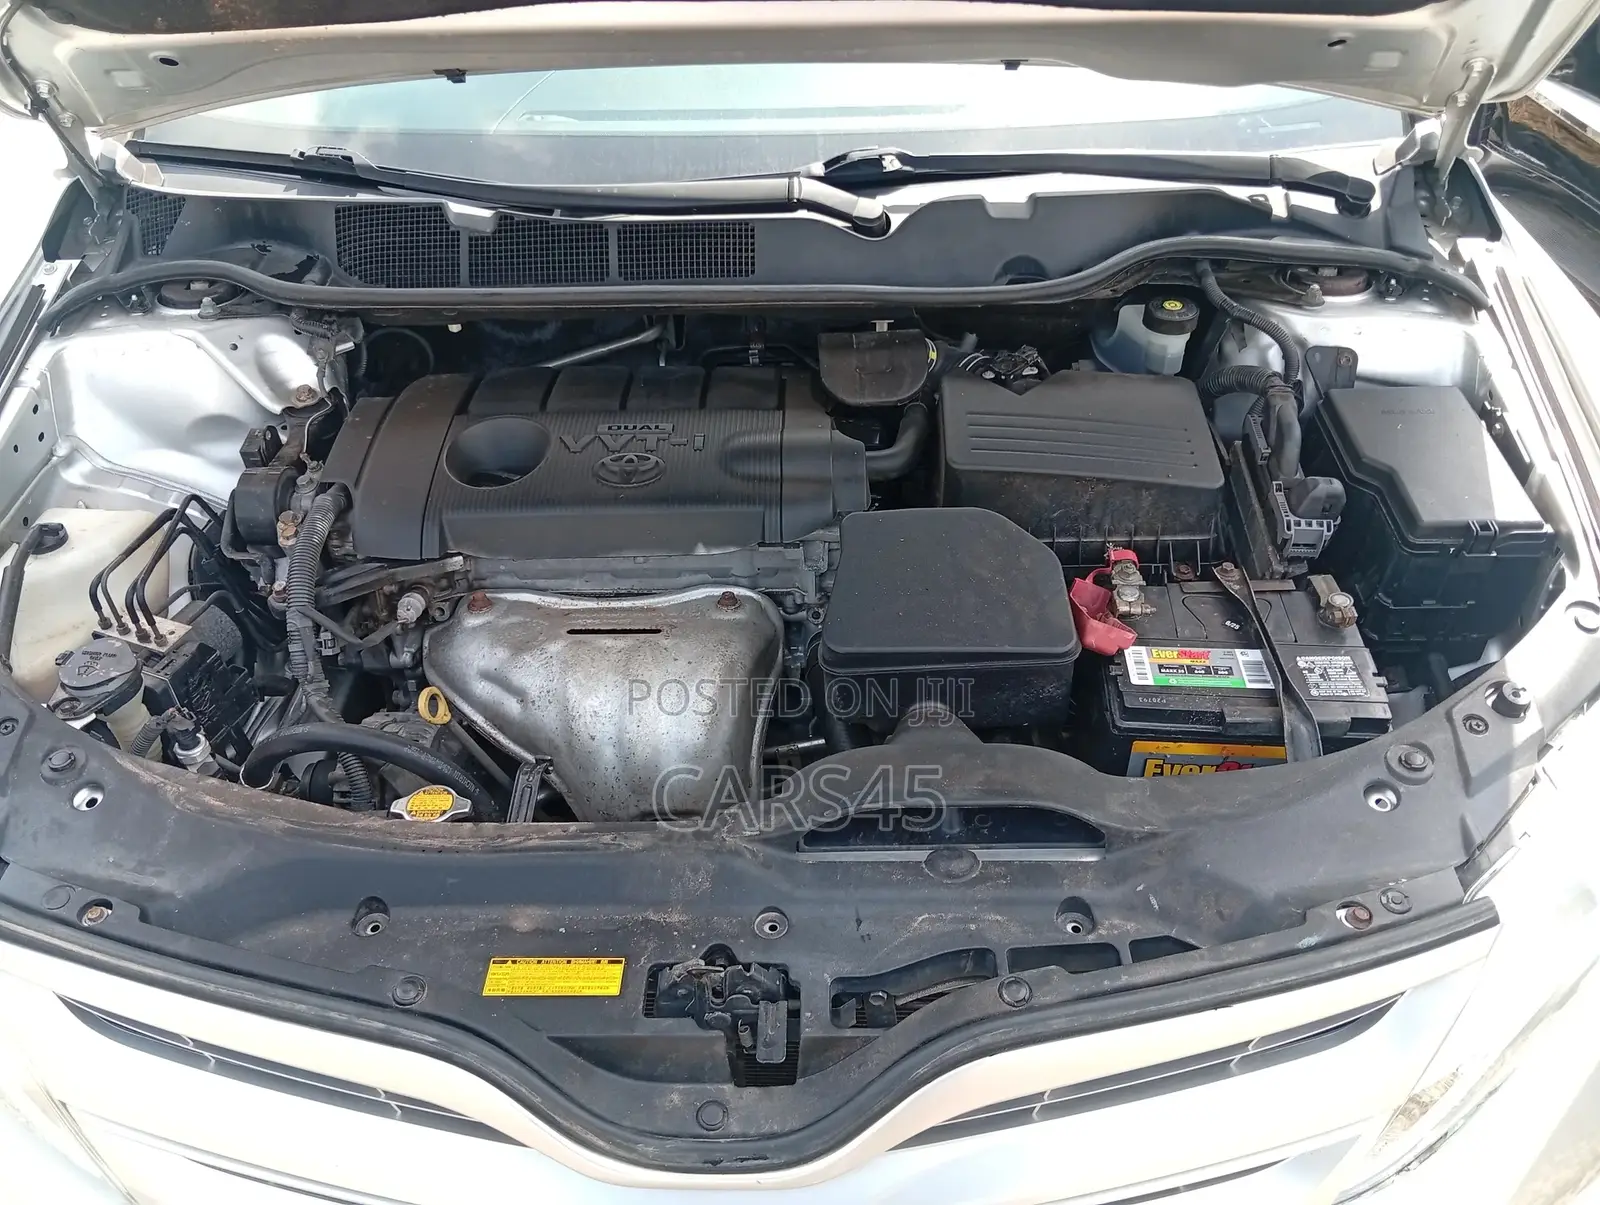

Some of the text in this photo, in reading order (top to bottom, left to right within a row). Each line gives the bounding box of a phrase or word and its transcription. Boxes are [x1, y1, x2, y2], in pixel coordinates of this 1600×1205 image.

[606, 423, 667, 432] DUAL
[559, 433, 706, 454] VVT-i
[1150, 648, 1211, 660] EverStart
